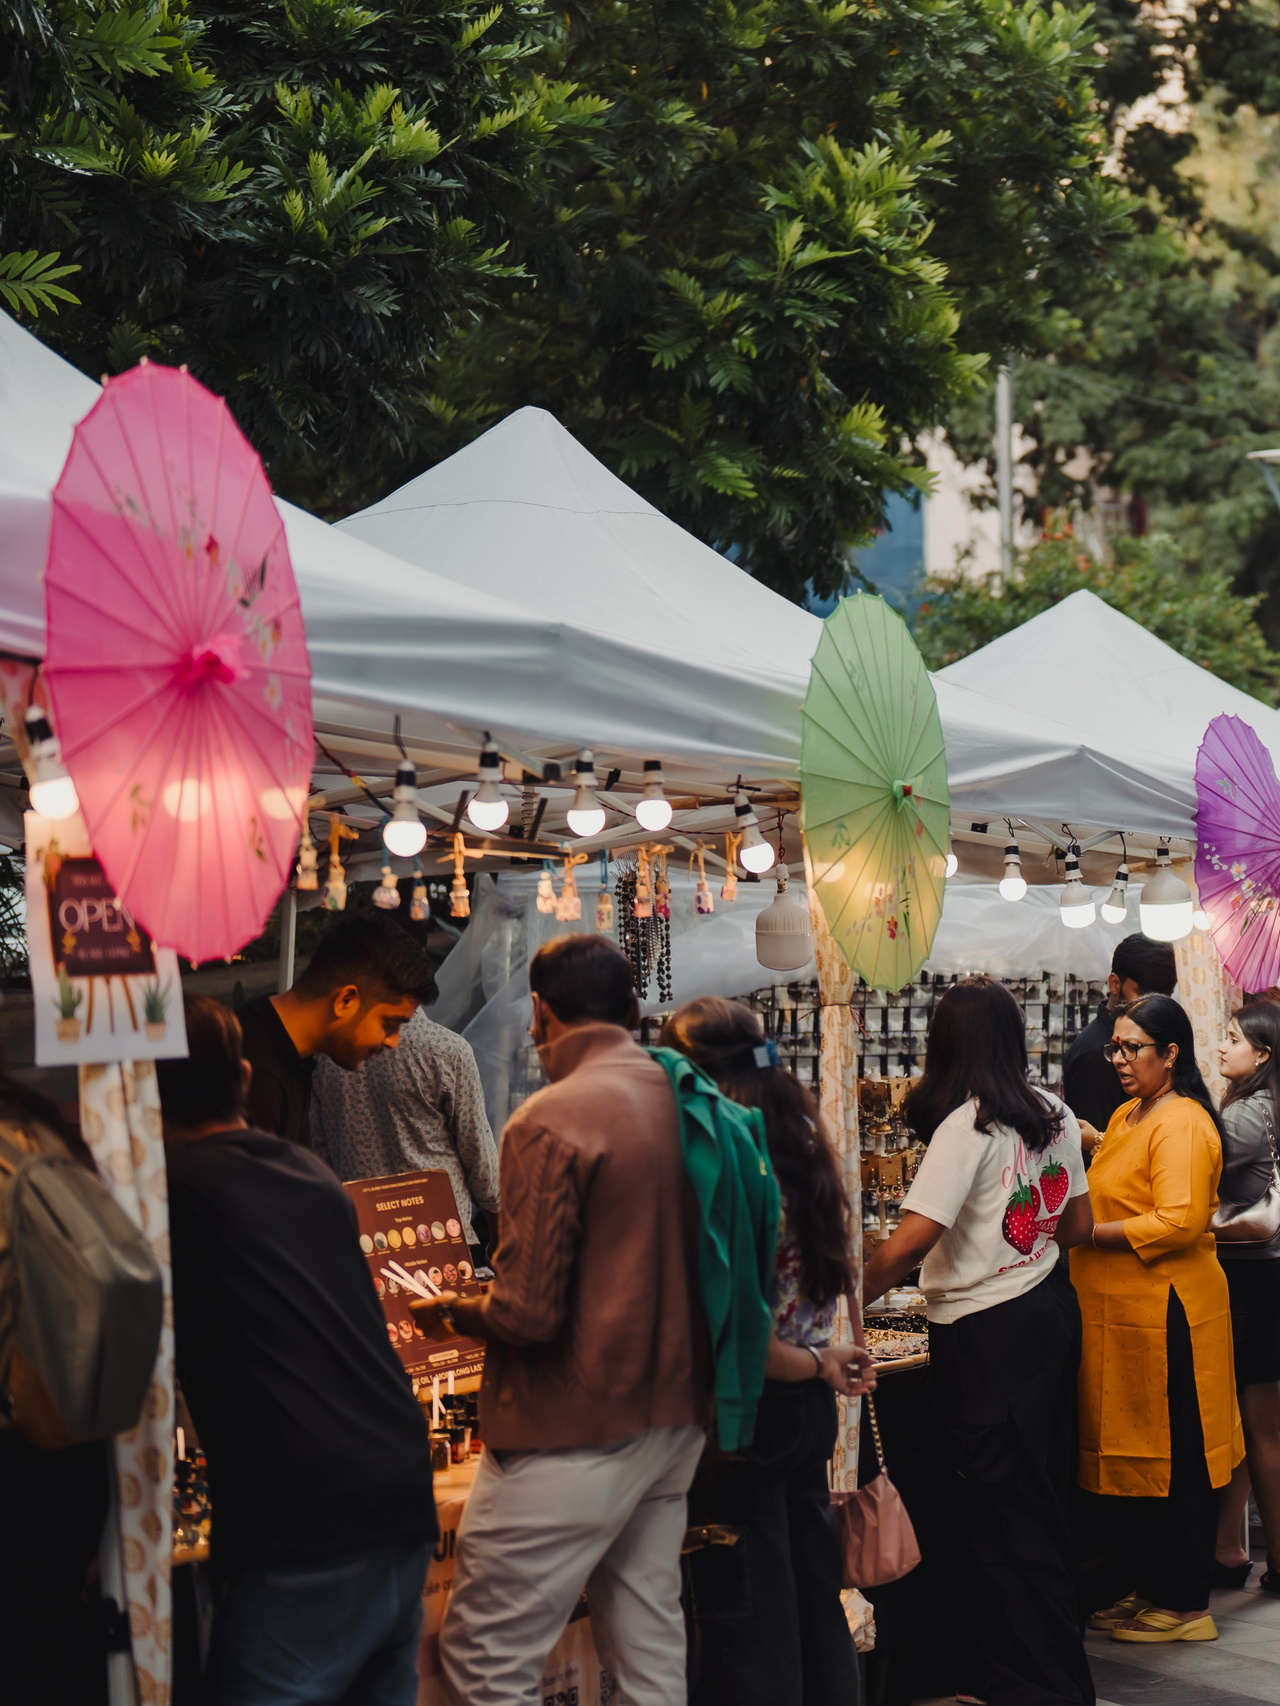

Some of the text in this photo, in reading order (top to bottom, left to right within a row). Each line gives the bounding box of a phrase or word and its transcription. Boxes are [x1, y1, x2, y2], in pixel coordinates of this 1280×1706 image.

[58, 897, 135, 933] OPEN
[375, 1195, 424, 1212] SELECT NOTES
